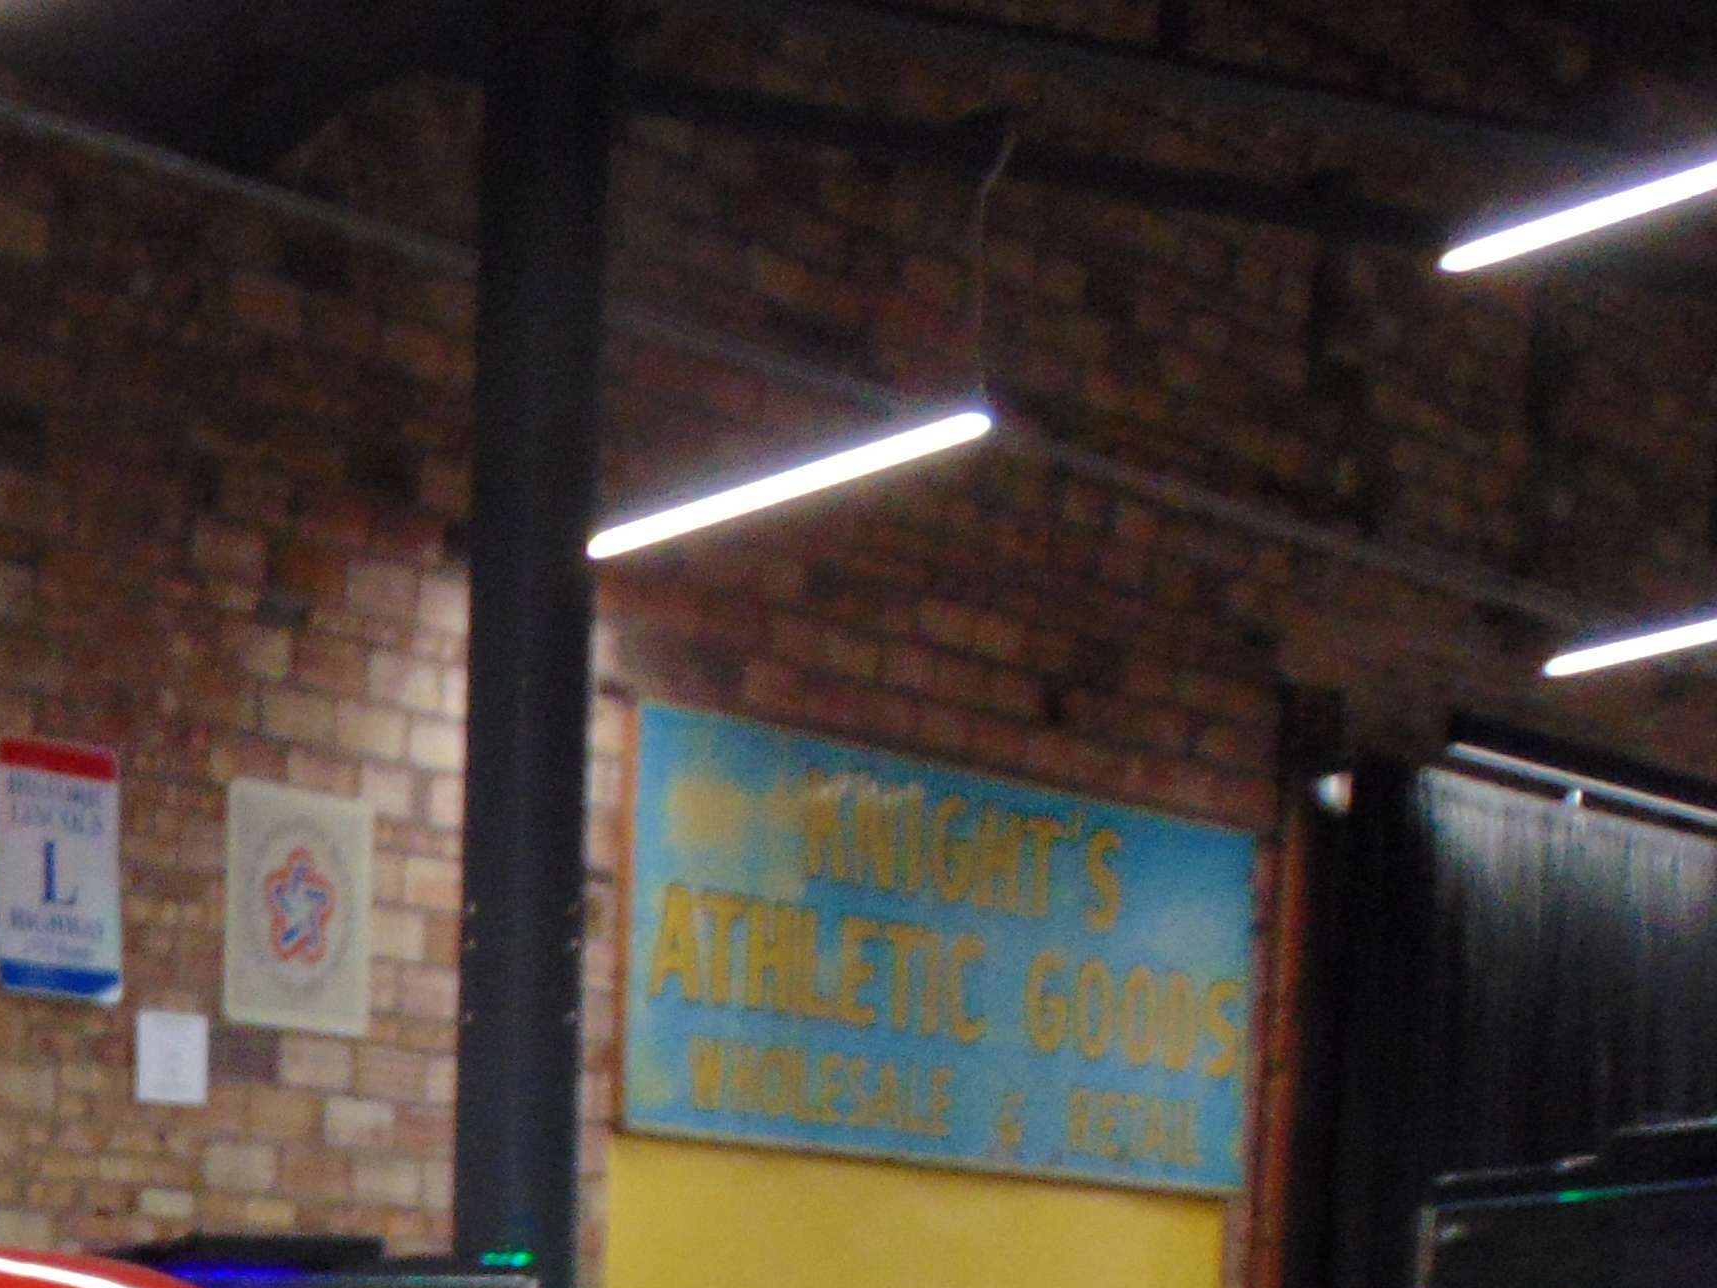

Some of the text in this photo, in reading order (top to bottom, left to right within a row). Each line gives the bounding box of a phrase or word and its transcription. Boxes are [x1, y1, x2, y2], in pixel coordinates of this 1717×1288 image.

[805, 768, 1124, 933] KNIGHT'S
[649, 882, 1243, 1079] ATHLETIC GOODS
[690, 1035, 953, 1136] WHOLESALE
[1069, 1085, 1202, 1168] RETAIL
